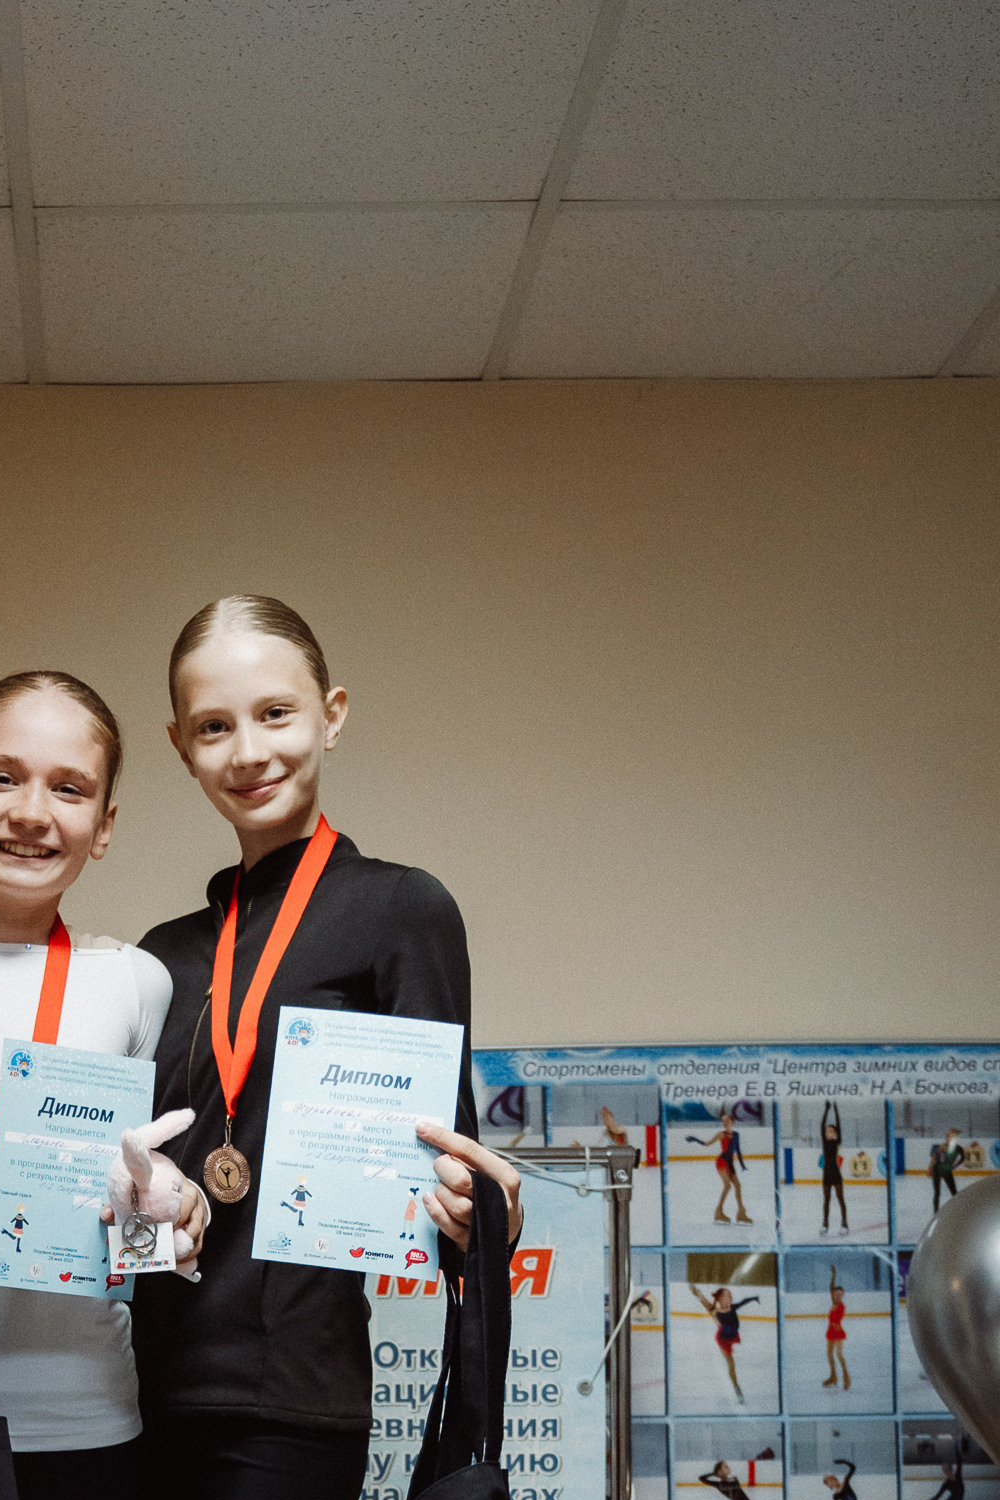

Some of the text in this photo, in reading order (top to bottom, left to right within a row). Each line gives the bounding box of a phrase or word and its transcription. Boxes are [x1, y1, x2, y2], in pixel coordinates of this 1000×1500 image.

[320, 1063, 412, 1090] Диплом
[523, 1060, 647, 1080] Спортсмены
[657, 1059, 760, 1076] отделения
[852, 1059, 919, 1074] зимних
[923, 1056, 979, 1074] видов
[329, 1090, 402, 1107] Награждается
[665, 1082, 739, 1099] Тренера
[37, 1096, 115, 1123] Диплом
[45, 1122, 107, 1140] Награждается
[297, 1129, 351, 1142] программе
[363, 1125, 392, 1136] место
[47, 1153, 57, 1161] за
[73, 1156, 98, 1166] место
[307, 1141, 369, 1155] результатом
[385, 1149, 420, 1161] баллов
[17, 1159, 63, 1173] программе
[64, 1165, 108, 1179] «Импрови
[26, 1171, 78, 1186] результатом
[92, 1179, 107, 1189] бал
[365, 1250, 394, 1260] ЮНИТОН
